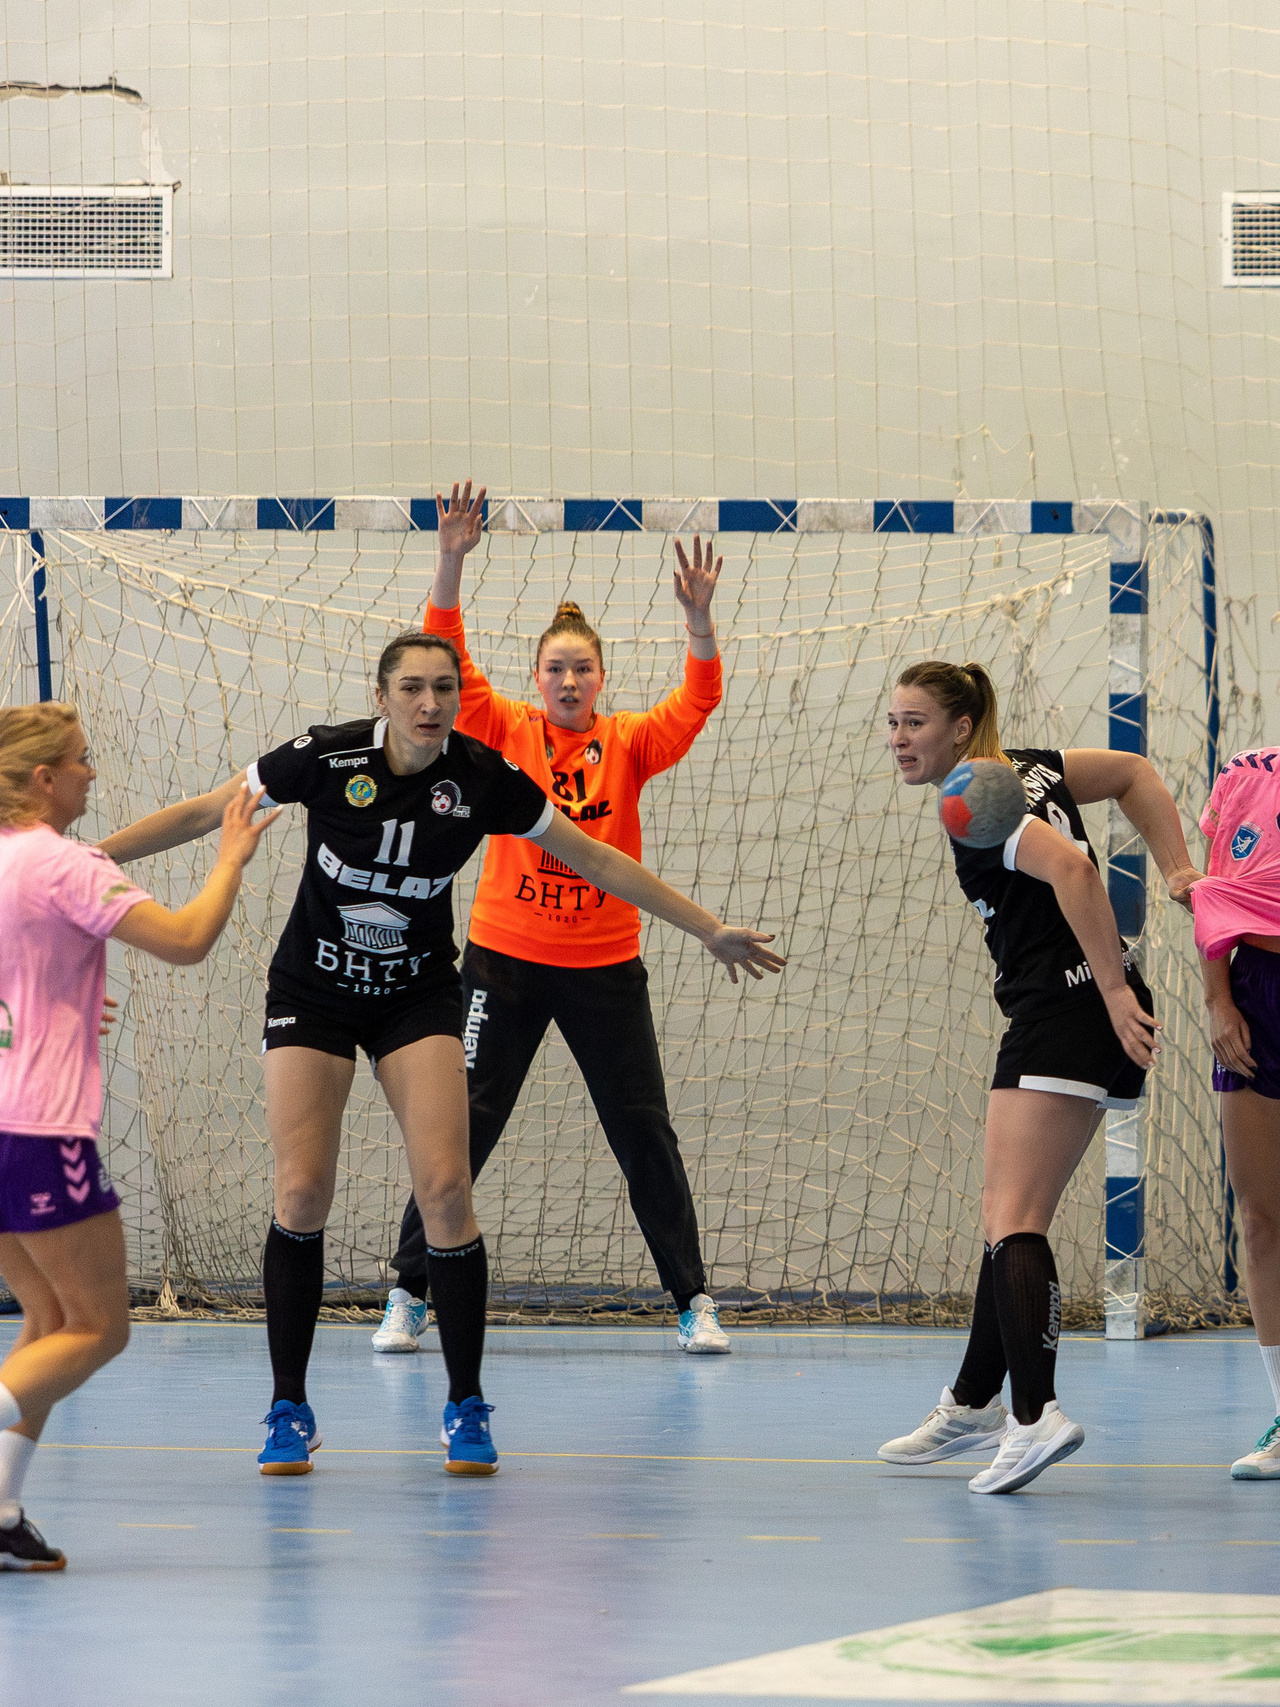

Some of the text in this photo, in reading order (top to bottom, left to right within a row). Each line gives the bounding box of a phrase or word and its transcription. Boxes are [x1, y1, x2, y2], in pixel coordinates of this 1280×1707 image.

[329, 756, 368, 768] Kempa
[552, 769, 587, 802] 81
[373, 818, 415, 867] 11
[548, 913, 577, 923] 1920
[314, 938, 431, 982] БНТУ
[353, 983, 391, 995] 1920
[267, 1016, 297, 1028] Kempa
[1042, 1281, 1061, 1352] Kempa
